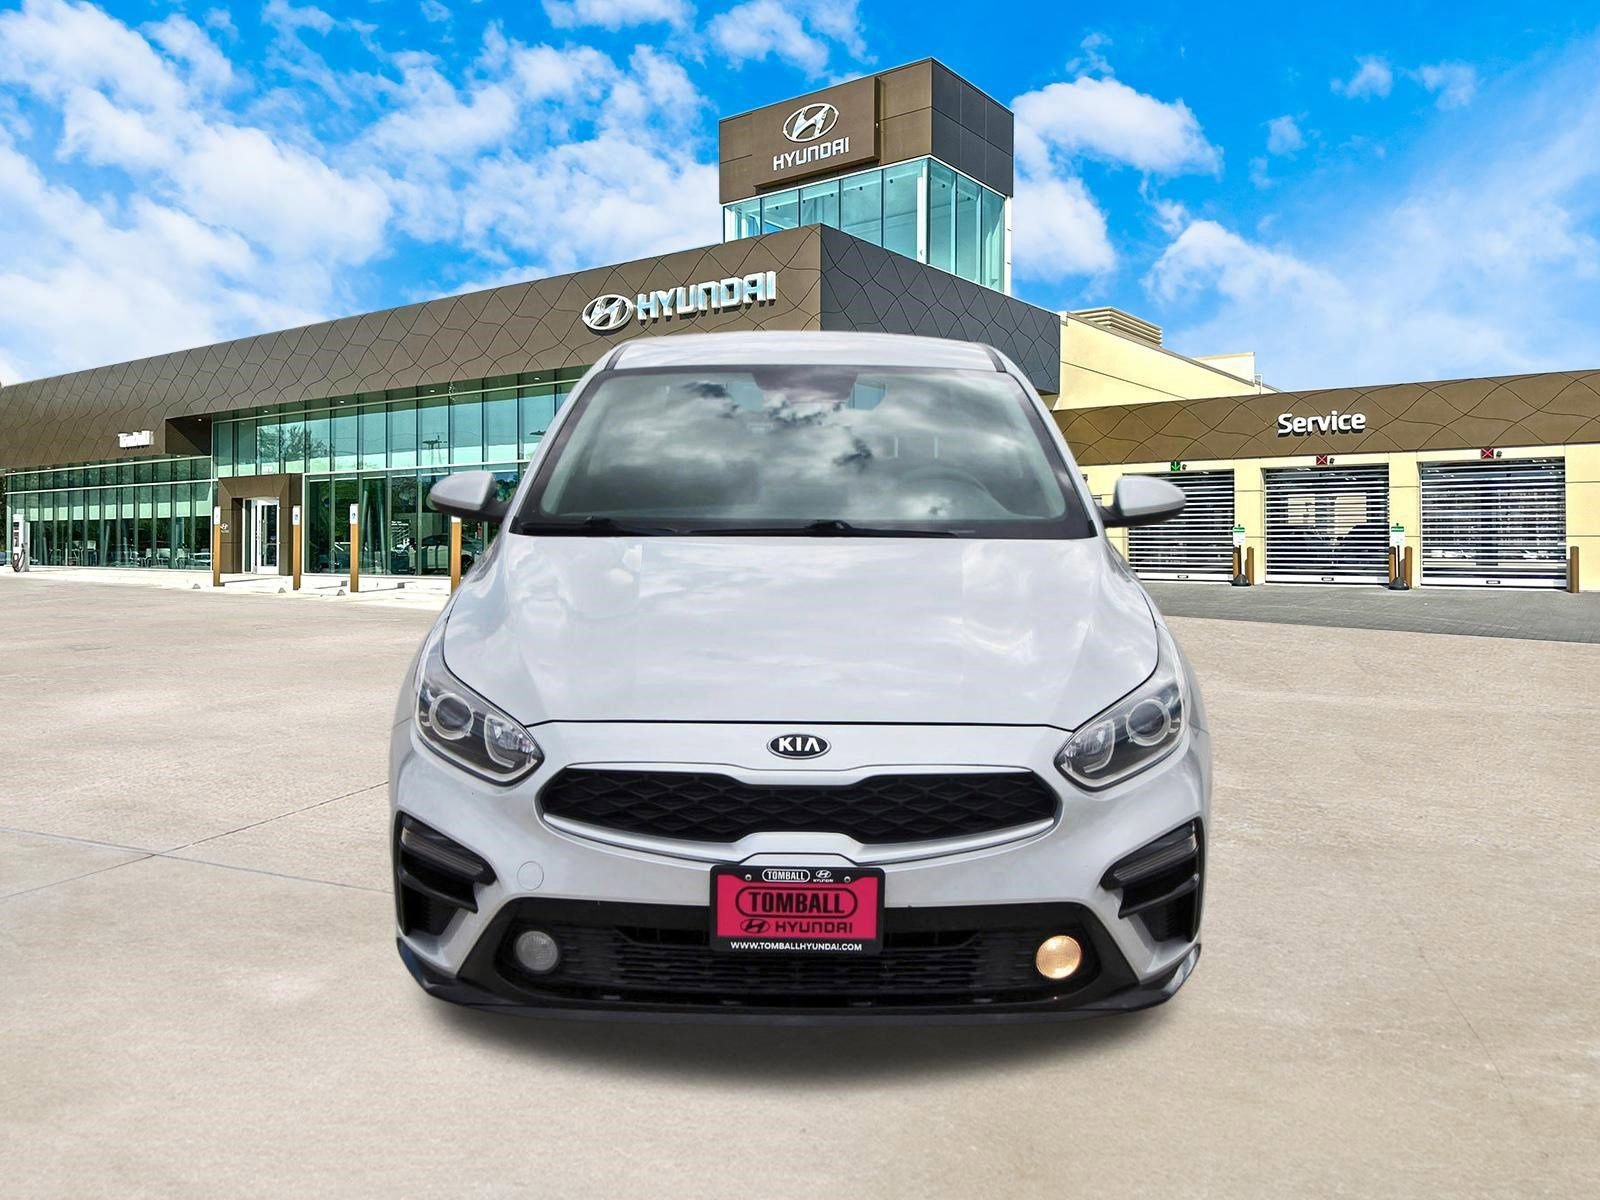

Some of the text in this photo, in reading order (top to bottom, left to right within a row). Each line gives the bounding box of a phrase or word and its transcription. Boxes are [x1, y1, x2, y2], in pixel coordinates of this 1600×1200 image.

[773, 136, 850, 171] HYUNDAI
[636, 270, 777, 321] HYUNDAI
[1277, 410, 1366, 435] Service
[778, 736, 821, 752] KIA
[767, 870, 806, 881] TOMBALL
[748, 891, 845, 914] TOMBALL
[775, 921, 853, 934] HYUNDAI
[730, 941, 862, 951] WWW.TOMBALLHYUNDAI.COM
